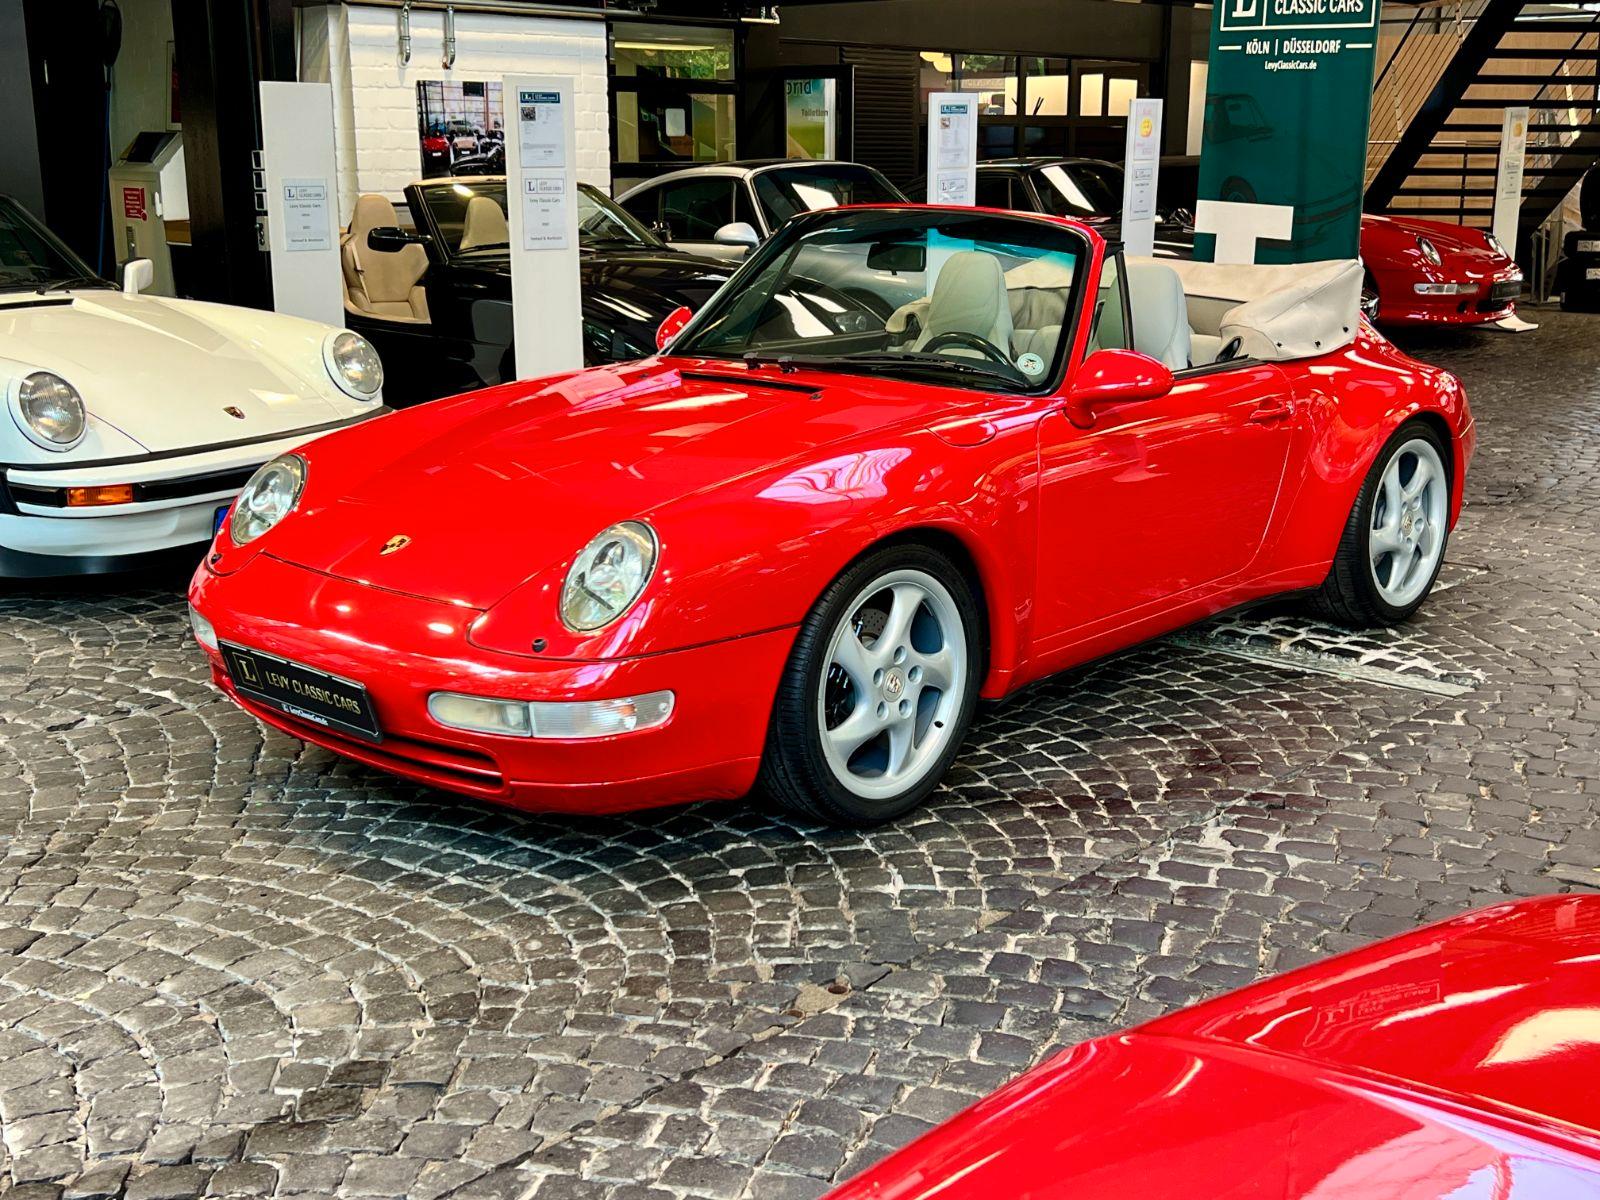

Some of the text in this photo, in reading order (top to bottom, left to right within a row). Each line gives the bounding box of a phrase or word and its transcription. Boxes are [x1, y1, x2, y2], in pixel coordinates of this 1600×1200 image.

[1274, 0, 1364, 15] CLASSIC CARS
[1245, 37, 1342, 55] KÖLN DÜSSELDORF
[1264, 60, 1318, 72] LevyClassicCars.de
[239, 659, 362, 715] L LEVY CLASSIC CARS
